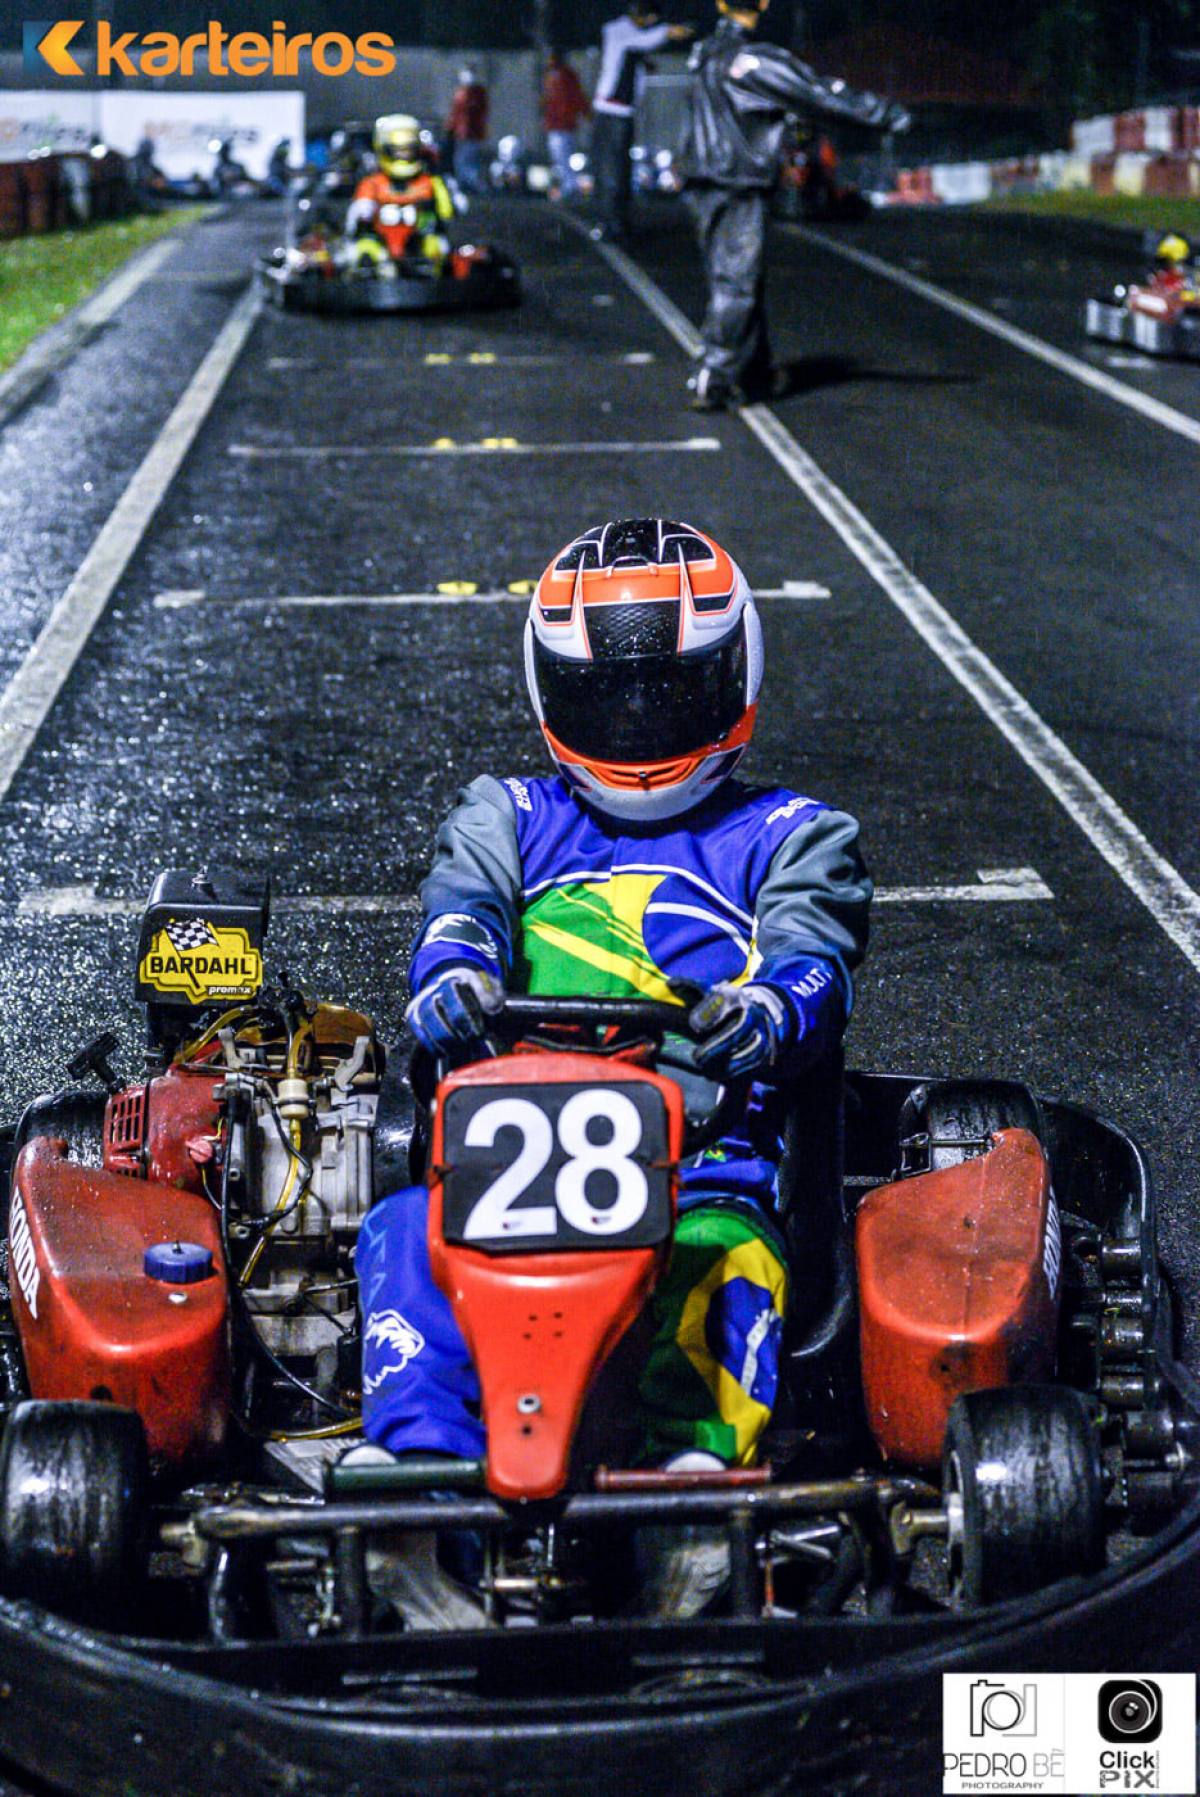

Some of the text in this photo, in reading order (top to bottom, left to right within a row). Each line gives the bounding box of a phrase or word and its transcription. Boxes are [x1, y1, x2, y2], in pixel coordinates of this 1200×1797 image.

[150, 956, 253, 975] BARDAHL
[463, 1088, 649, 1240] 28
[9, 1185, 41, 1320] HONDA
